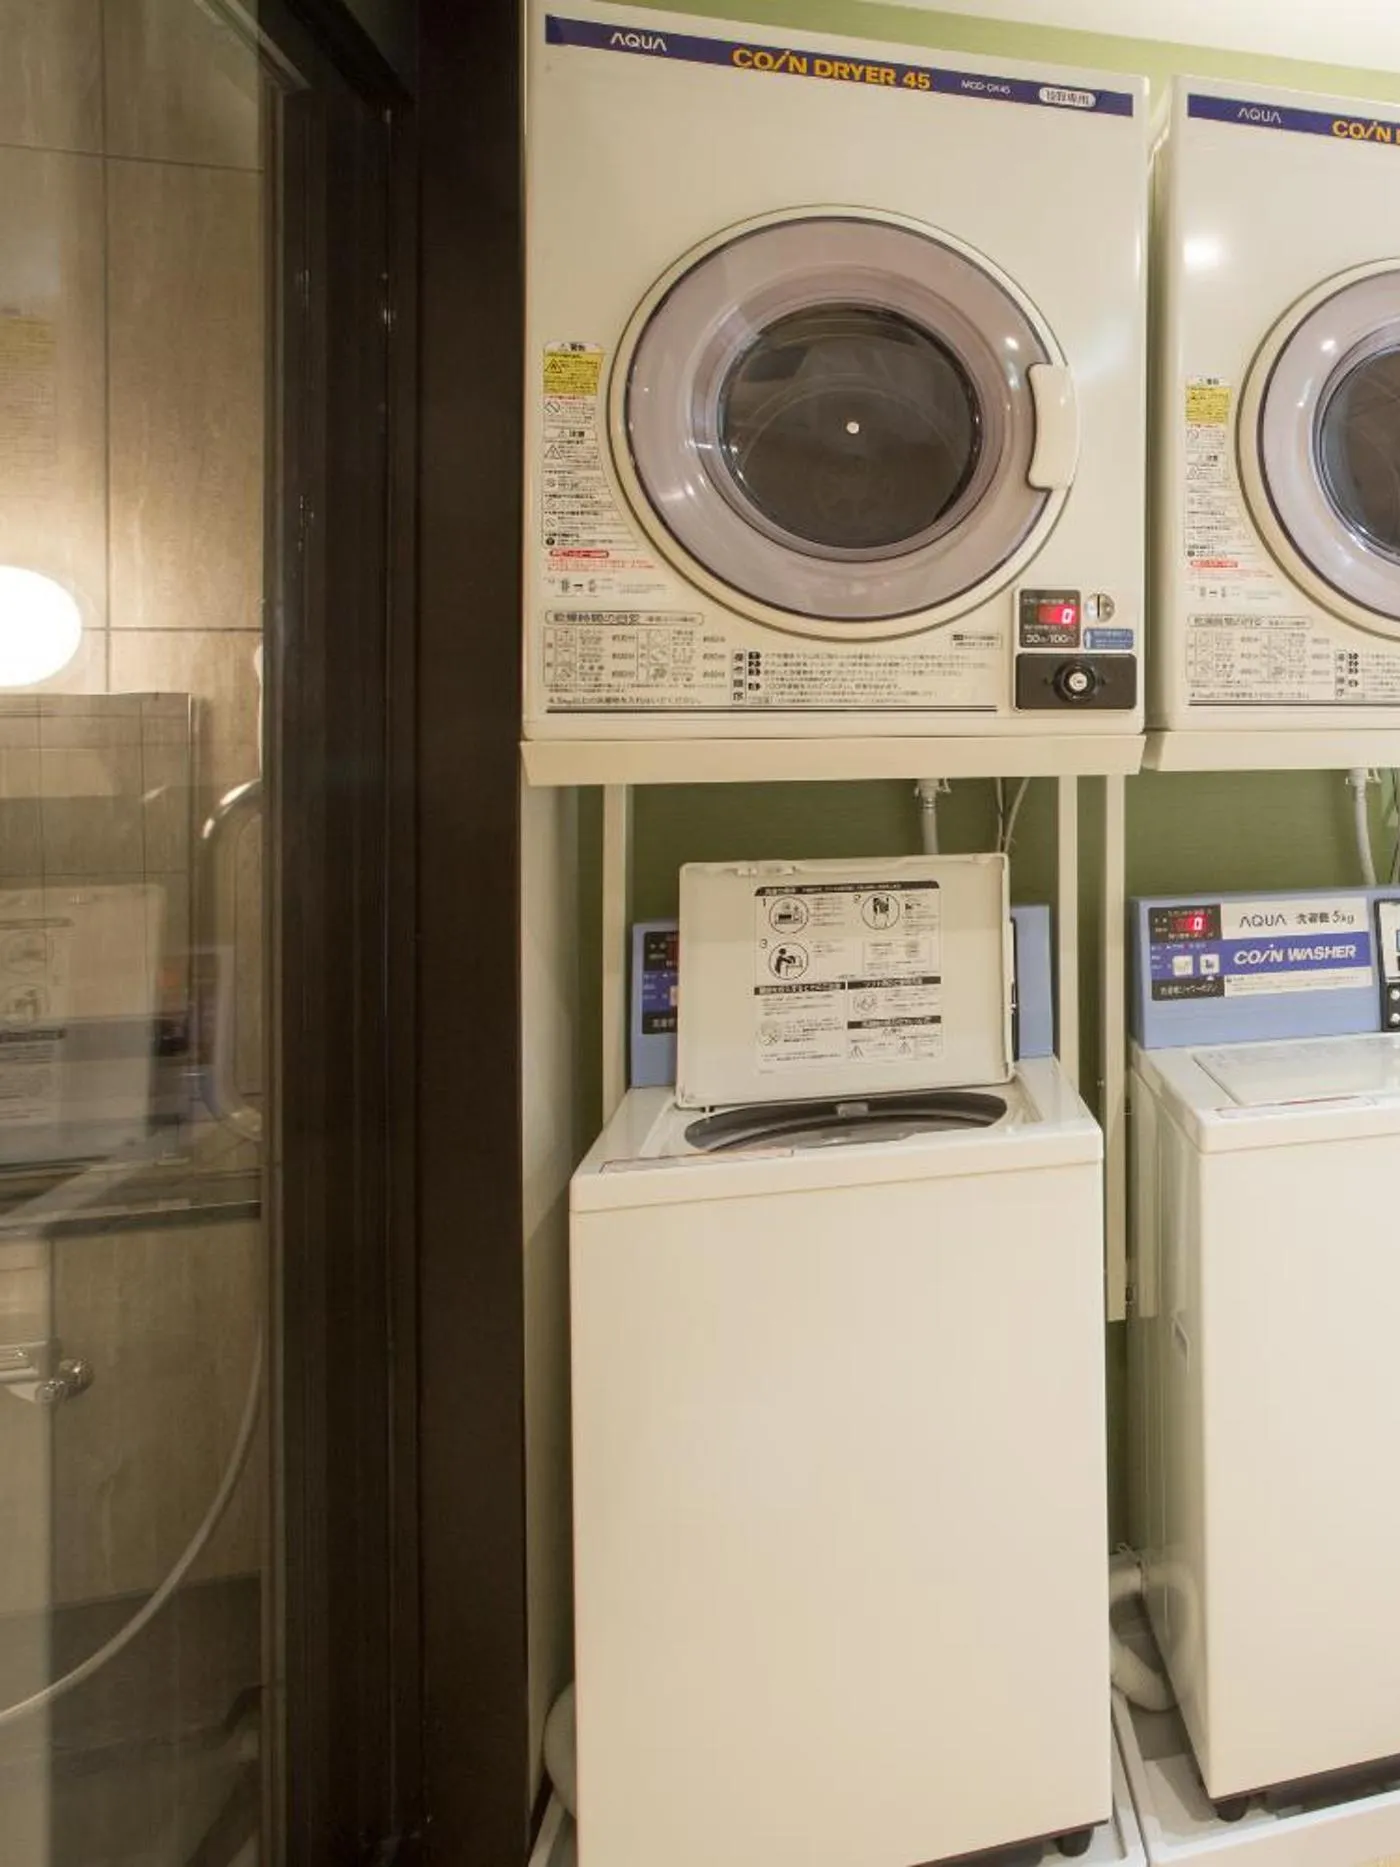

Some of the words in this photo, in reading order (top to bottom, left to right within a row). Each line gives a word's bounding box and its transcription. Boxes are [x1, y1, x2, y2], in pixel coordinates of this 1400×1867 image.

[610, 32, 668, 52] AQUA
[732, 48, 808, 75] COIN
[814, 59, 896, 86] DRYER
[902, 70, 931, 89] 45
[1237, 107, 1282, 124] AQUA
[1331, 119, 1391, 143] COIN
[1061, 608, 1073, 624] 0
[1193, 916, 1203, 931] 0
[1239, 913, 1288, 928] AQUA
[760, 938, 769, 949] 3
[1233, 943, 1284, 965] COIN
[1287, 944, 1357, 962] WASHER
